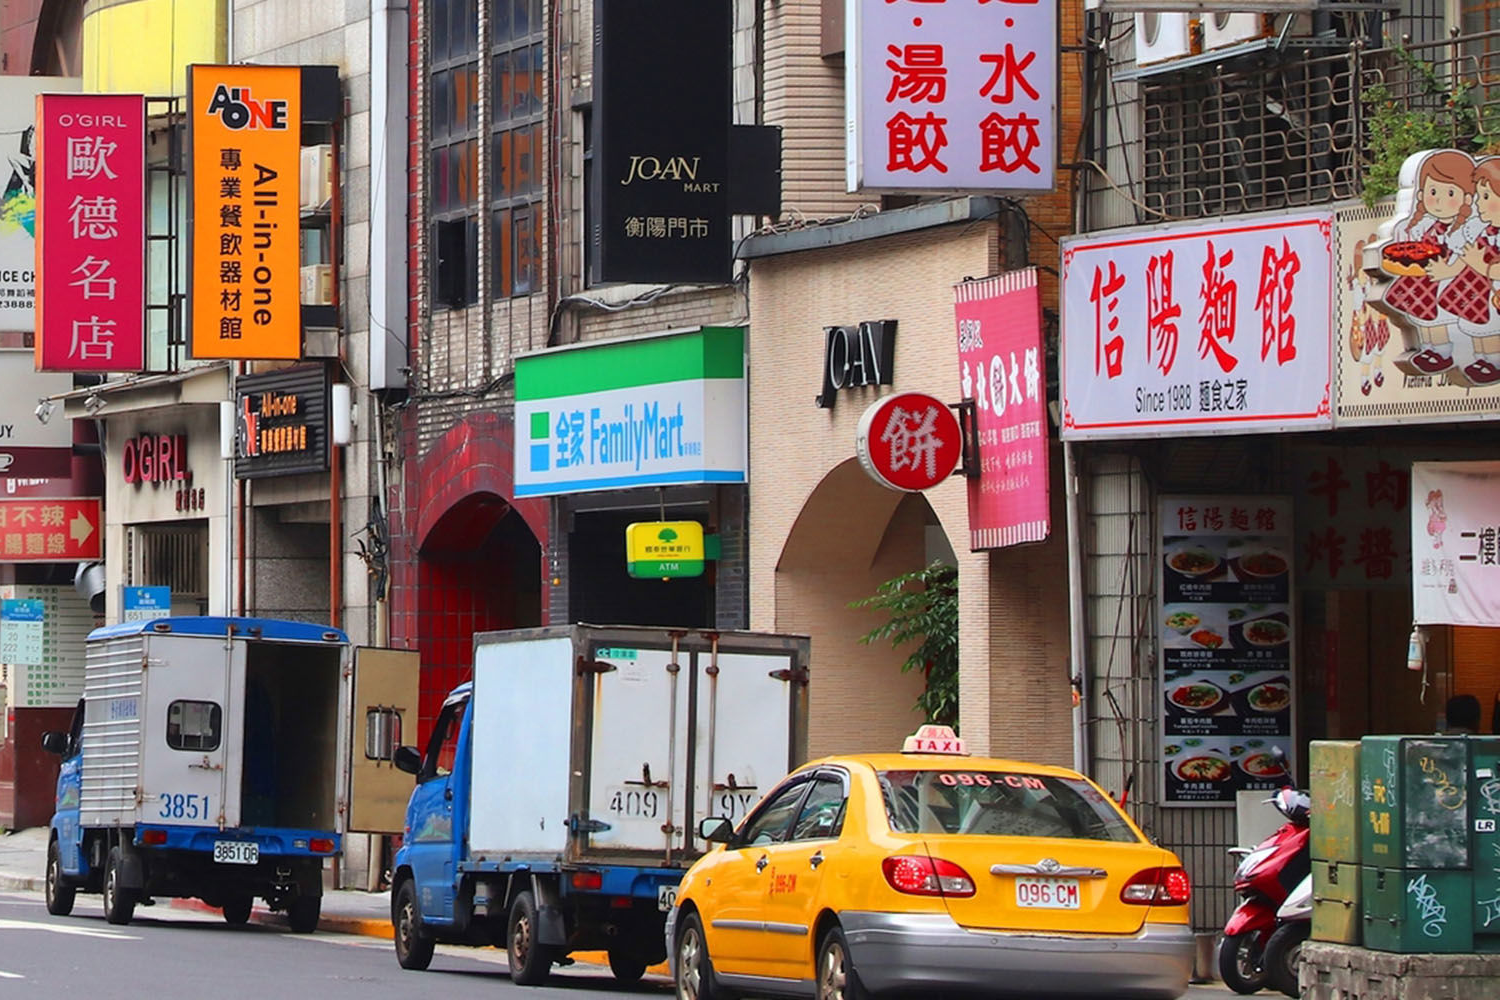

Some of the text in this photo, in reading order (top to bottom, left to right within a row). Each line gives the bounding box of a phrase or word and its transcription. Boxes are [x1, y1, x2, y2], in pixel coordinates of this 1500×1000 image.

[59, 114, 128, 128] O'GIRL
[621, 155, 700, 186] JOAN
[683, 182, 721, 193] MART
[624, 216, 709, 239] 衡陽門市
[66, 135, 119, 362] 歐德名店
[219, 147, 243, 340] 專業餐飲器材館
[253, 163, 278, 326] All-in-one
[1089, 234, 1301, 379] 信陽麵館
[1135, 387, 1164, 413] Since
[1167, 385, 1192, 411] 1988
[556, 401, 684, 471] 全家 FamilyMart
[881, 404, 943, 479] 餅
[122, 435, 185, 484] O'GIRL
[1177, 506, 1276, 531] 信陽麵館
[659, 562, 680, 571] ATM
[915, 739, 961, 752] TAXI
[939, 772, 1047, 791] 096-CM
[159, 792, 209, 820] 3851
[1478, 820, 1494, 831] LR
